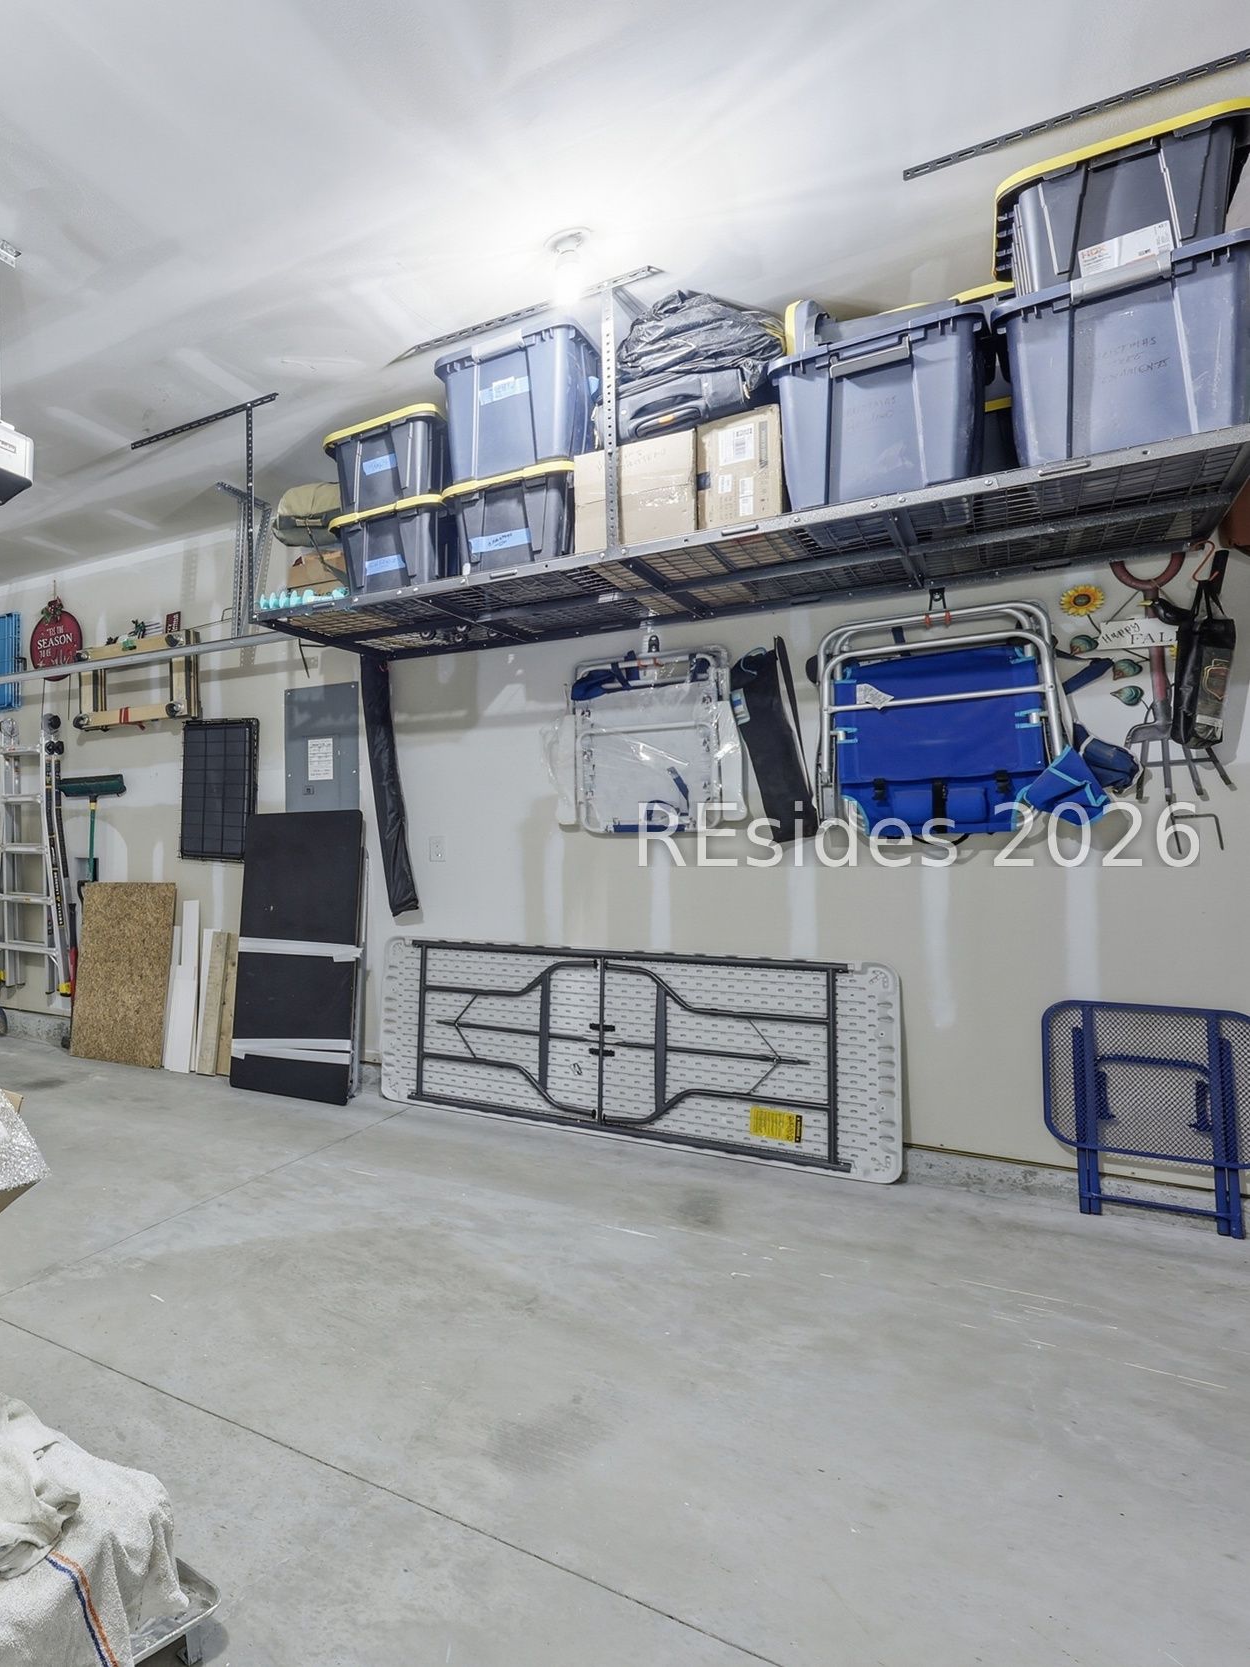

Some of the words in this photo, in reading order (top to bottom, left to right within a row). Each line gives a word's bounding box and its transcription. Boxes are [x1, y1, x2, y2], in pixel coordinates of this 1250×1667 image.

[1101, 622, 1140, 643] Happy
[1130, 631, 1178, 645] FAL
[37, 633, 73, 650] SEASON
